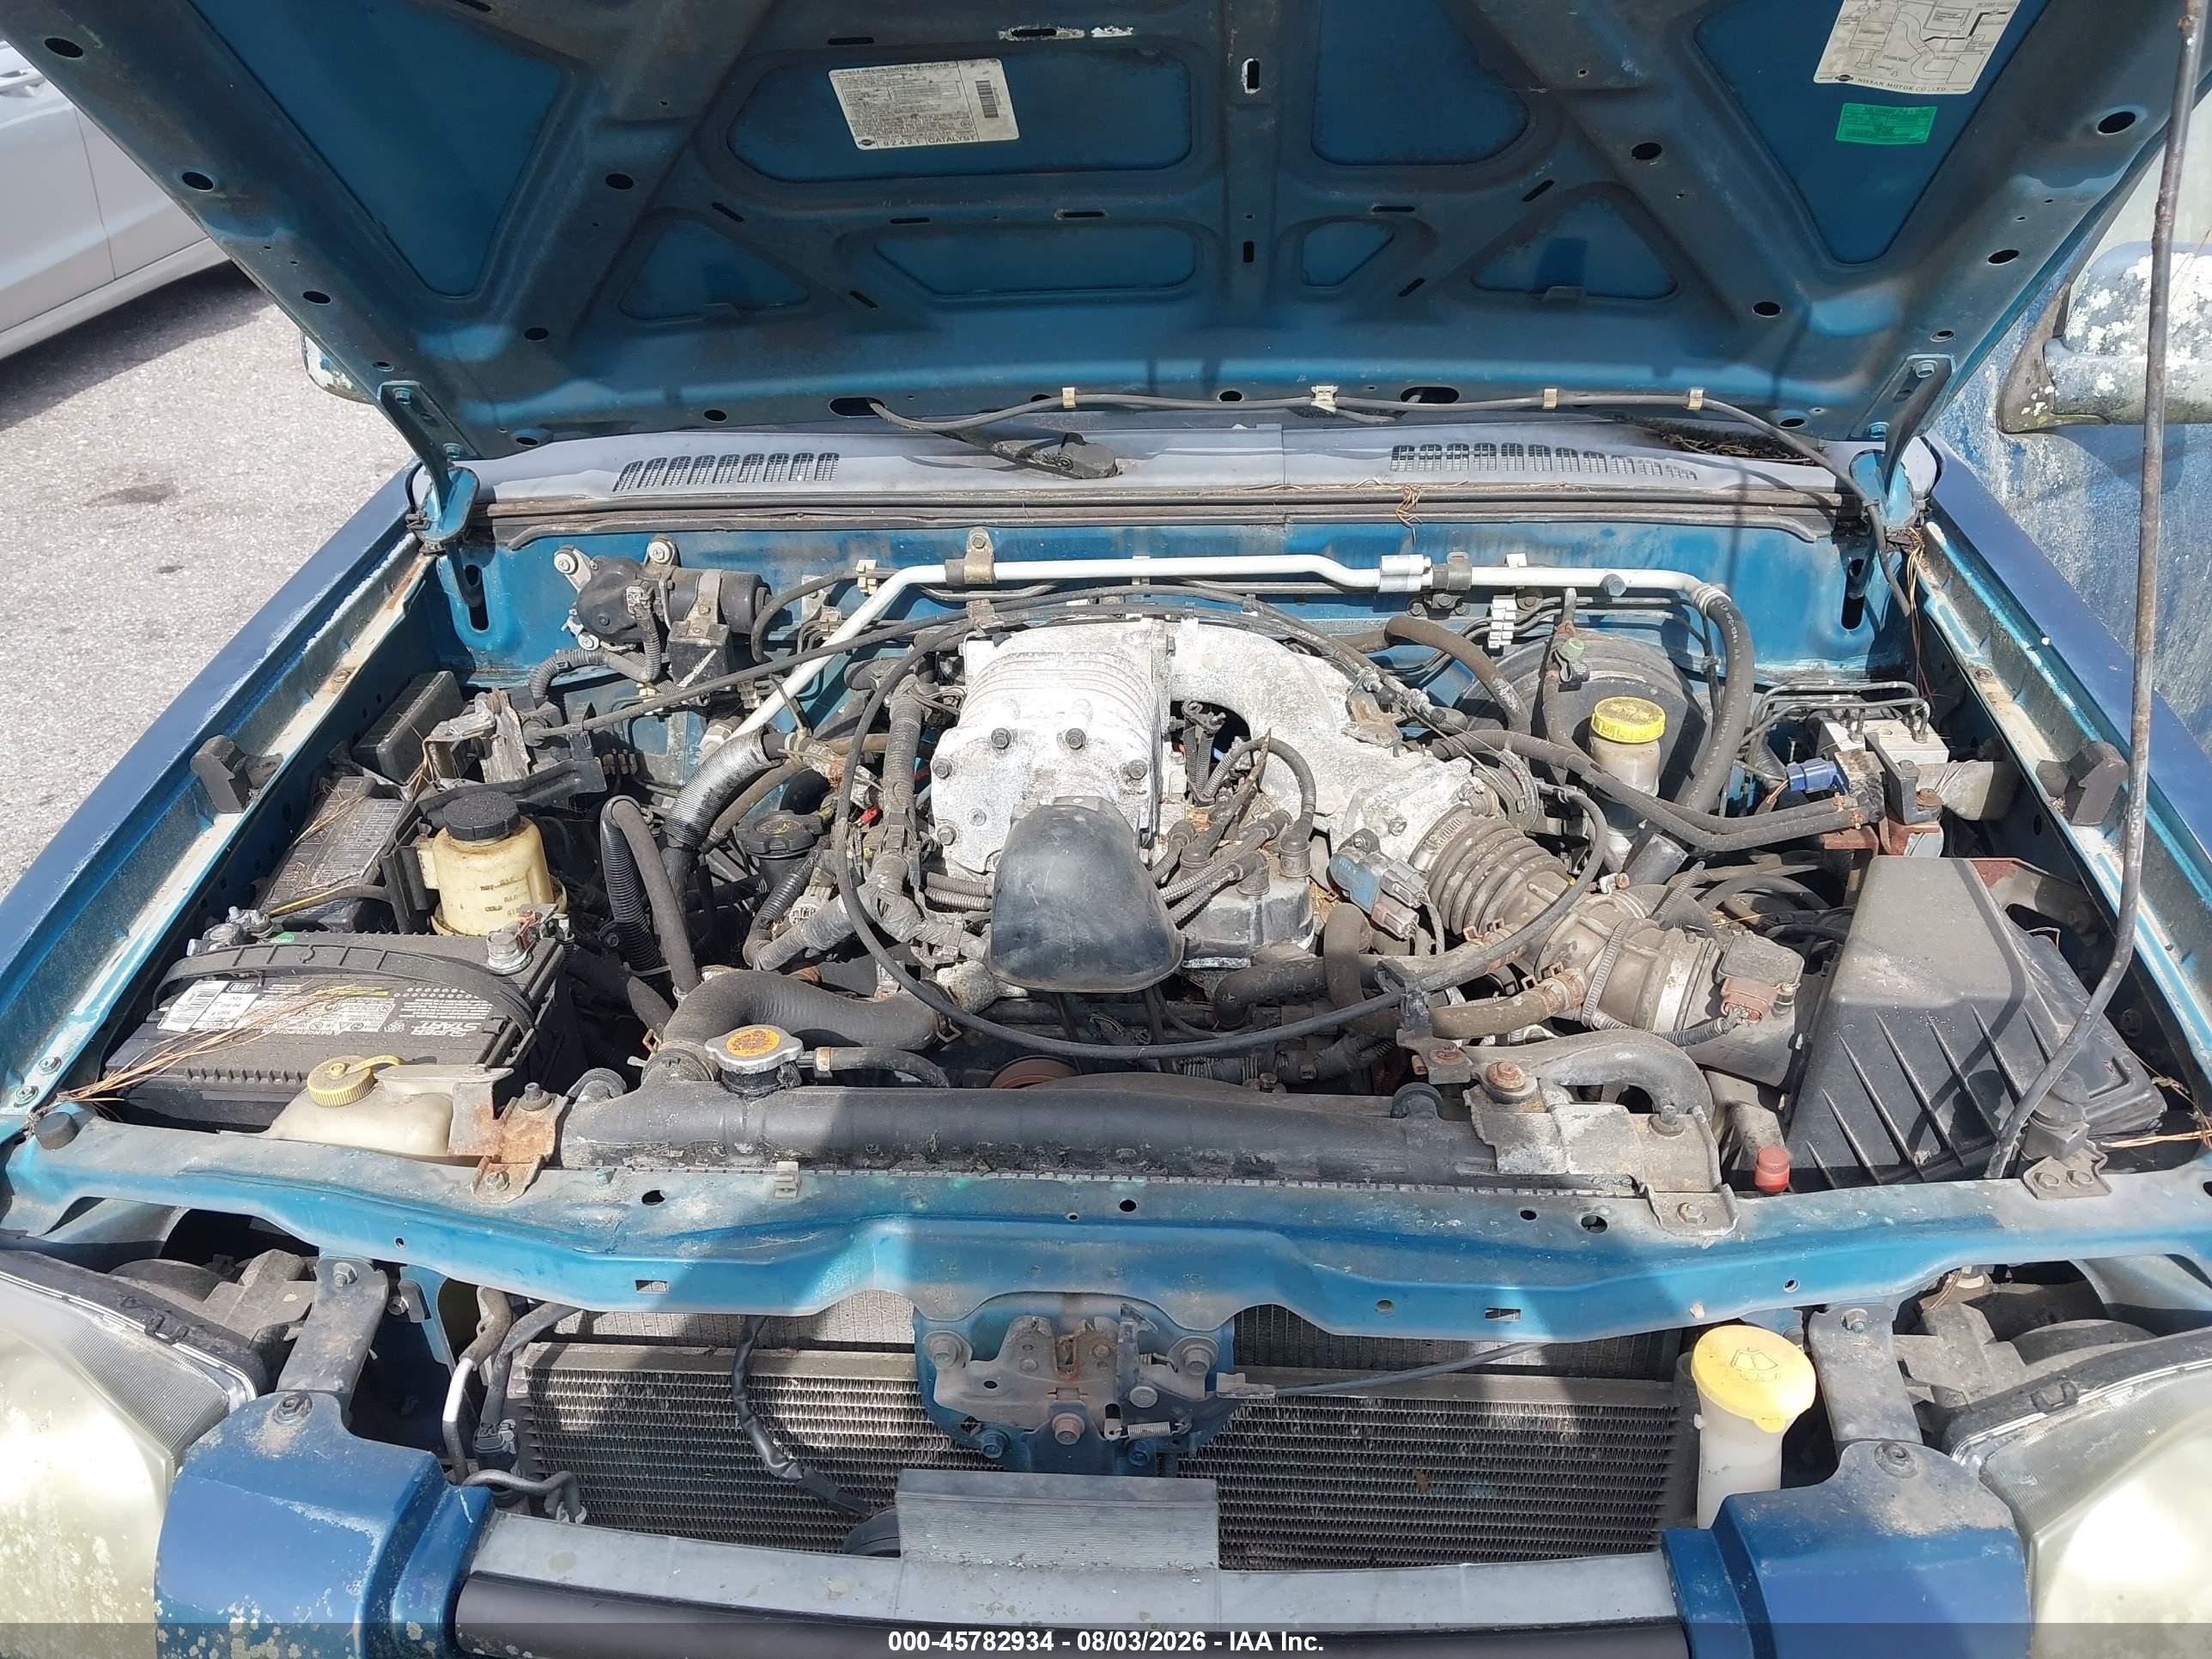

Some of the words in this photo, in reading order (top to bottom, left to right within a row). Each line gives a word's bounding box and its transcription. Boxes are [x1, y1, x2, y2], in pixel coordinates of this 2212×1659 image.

[1857, 77, 1884, 87] NISSAN
[927, 135, 975, 143] CATALYST
[420, 1021, 482, 1031] START
[410, 1029, 467, 1037] SUPER
